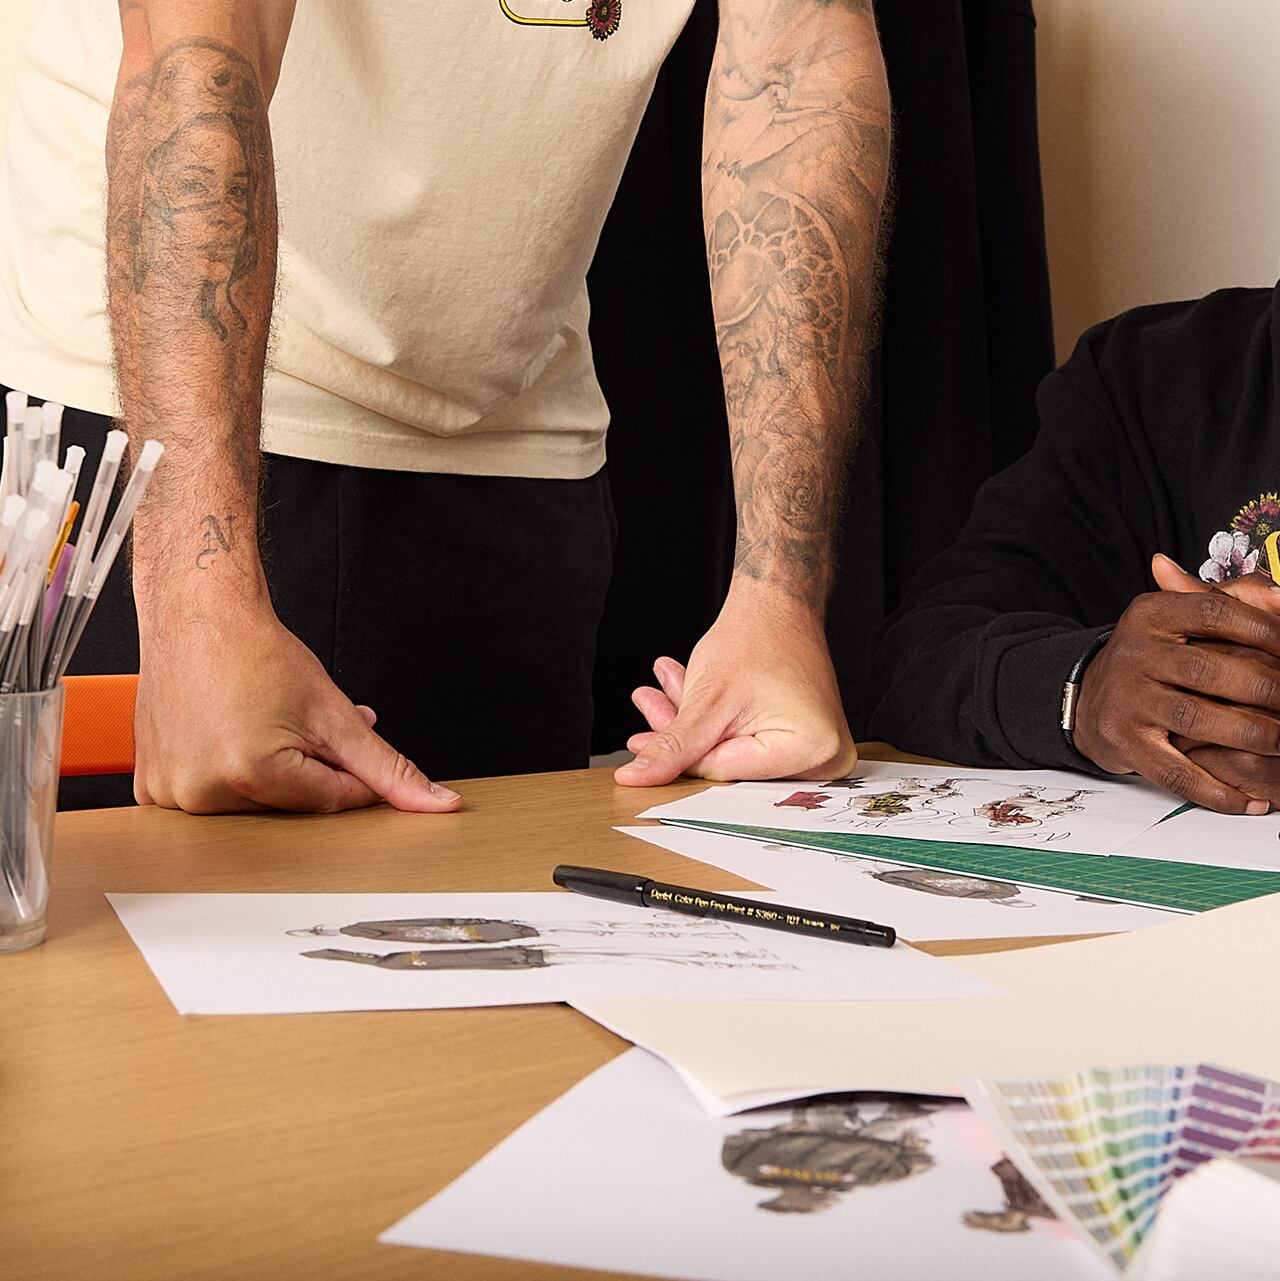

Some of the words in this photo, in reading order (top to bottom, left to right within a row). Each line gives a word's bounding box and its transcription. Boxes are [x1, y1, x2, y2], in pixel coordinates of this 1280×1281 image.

[650, 888, 673, 902] Pentel
[674, 893, 694, 905] Color
[695, 896, 709, 908] Pen
[710, 899, 725, 911] Fine
[726, 902, 746, 916] Point
